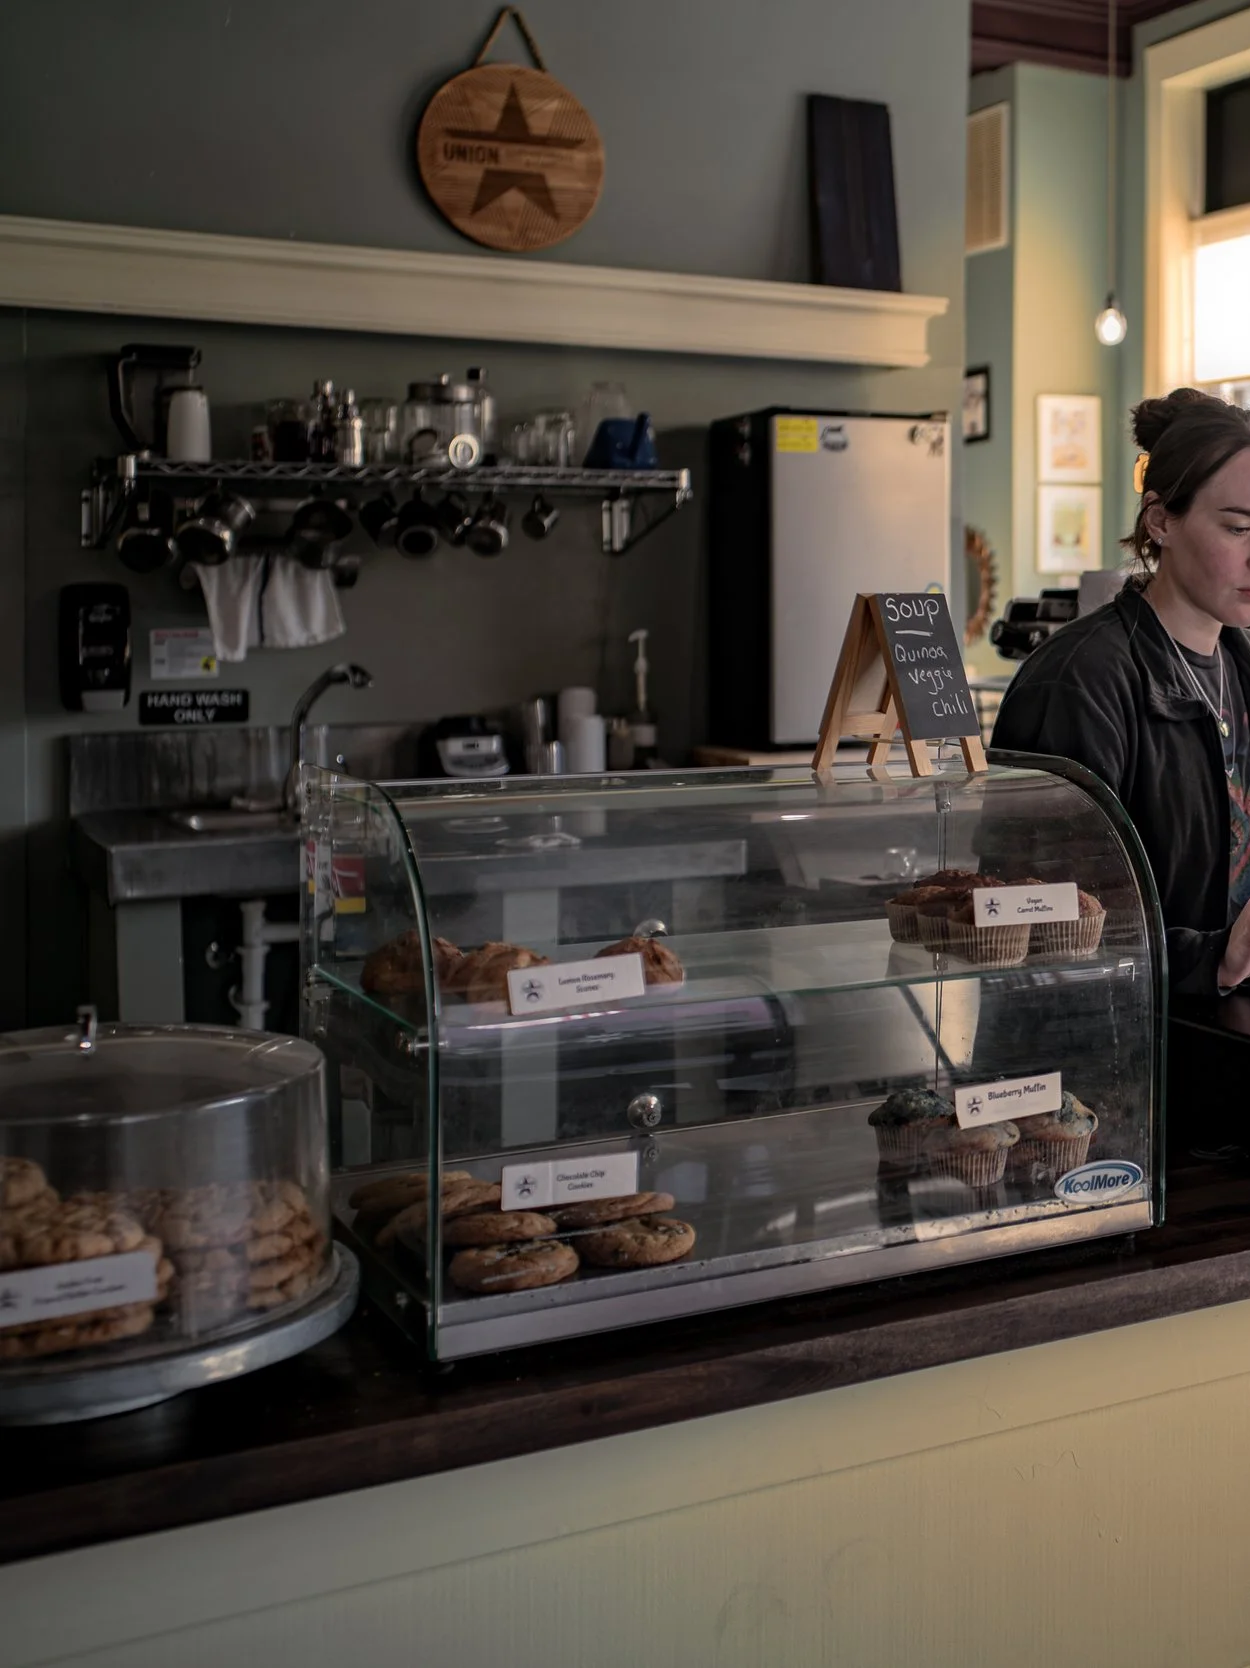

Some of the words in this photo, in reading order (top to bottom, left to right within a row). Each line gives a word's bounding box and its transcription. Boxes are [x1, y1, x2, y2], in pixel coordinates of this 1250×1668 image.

[443, 142, 499, 164] UNION
[895, 643, 949, 663] Quinoa
[146, 693, 191, 707] HAND
[196, 692, 242, 706] WASH
[174, 709, 216, 723] ONLY
[987, 1088, 1022, 1101] Blueberry
[1023, 1082, 1047, 1095] Muffin
[556, 1172, 588, 1182] Chocolate
[589, 1169, 605, 1179] Chip
[1063, 1172, 1130, 1195] KoolMore
[567, 1181, 594, 1191] Cookies
